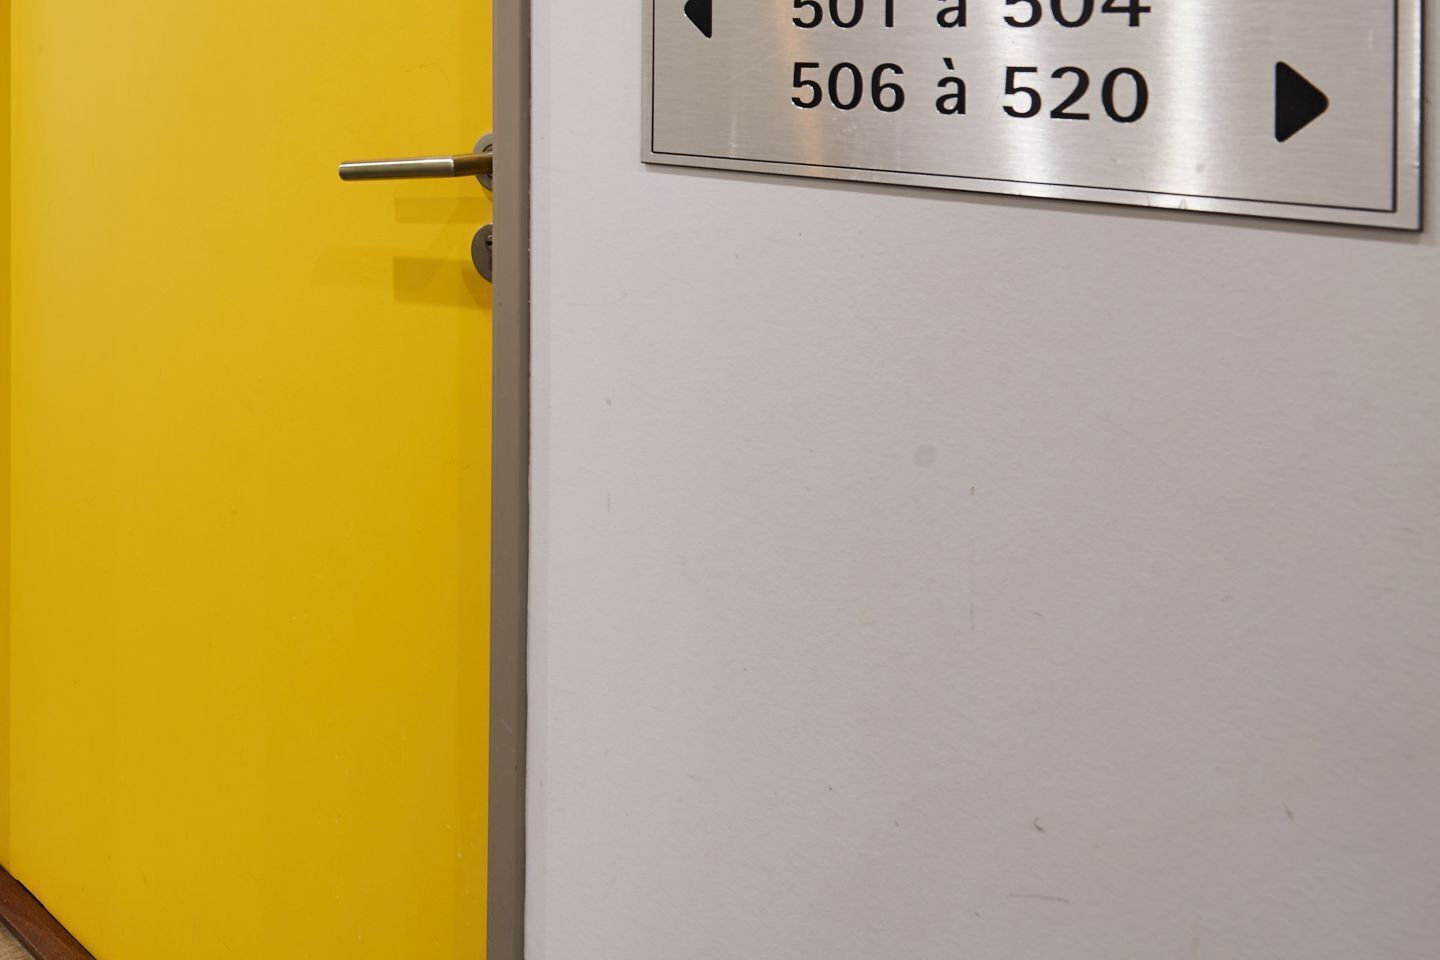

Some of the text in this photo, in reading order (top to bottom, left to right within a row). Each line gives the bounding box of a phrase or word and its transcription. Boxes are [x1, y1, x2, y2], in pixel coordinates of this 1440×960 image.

[791, 57, 1150, 124] 506 à 520
